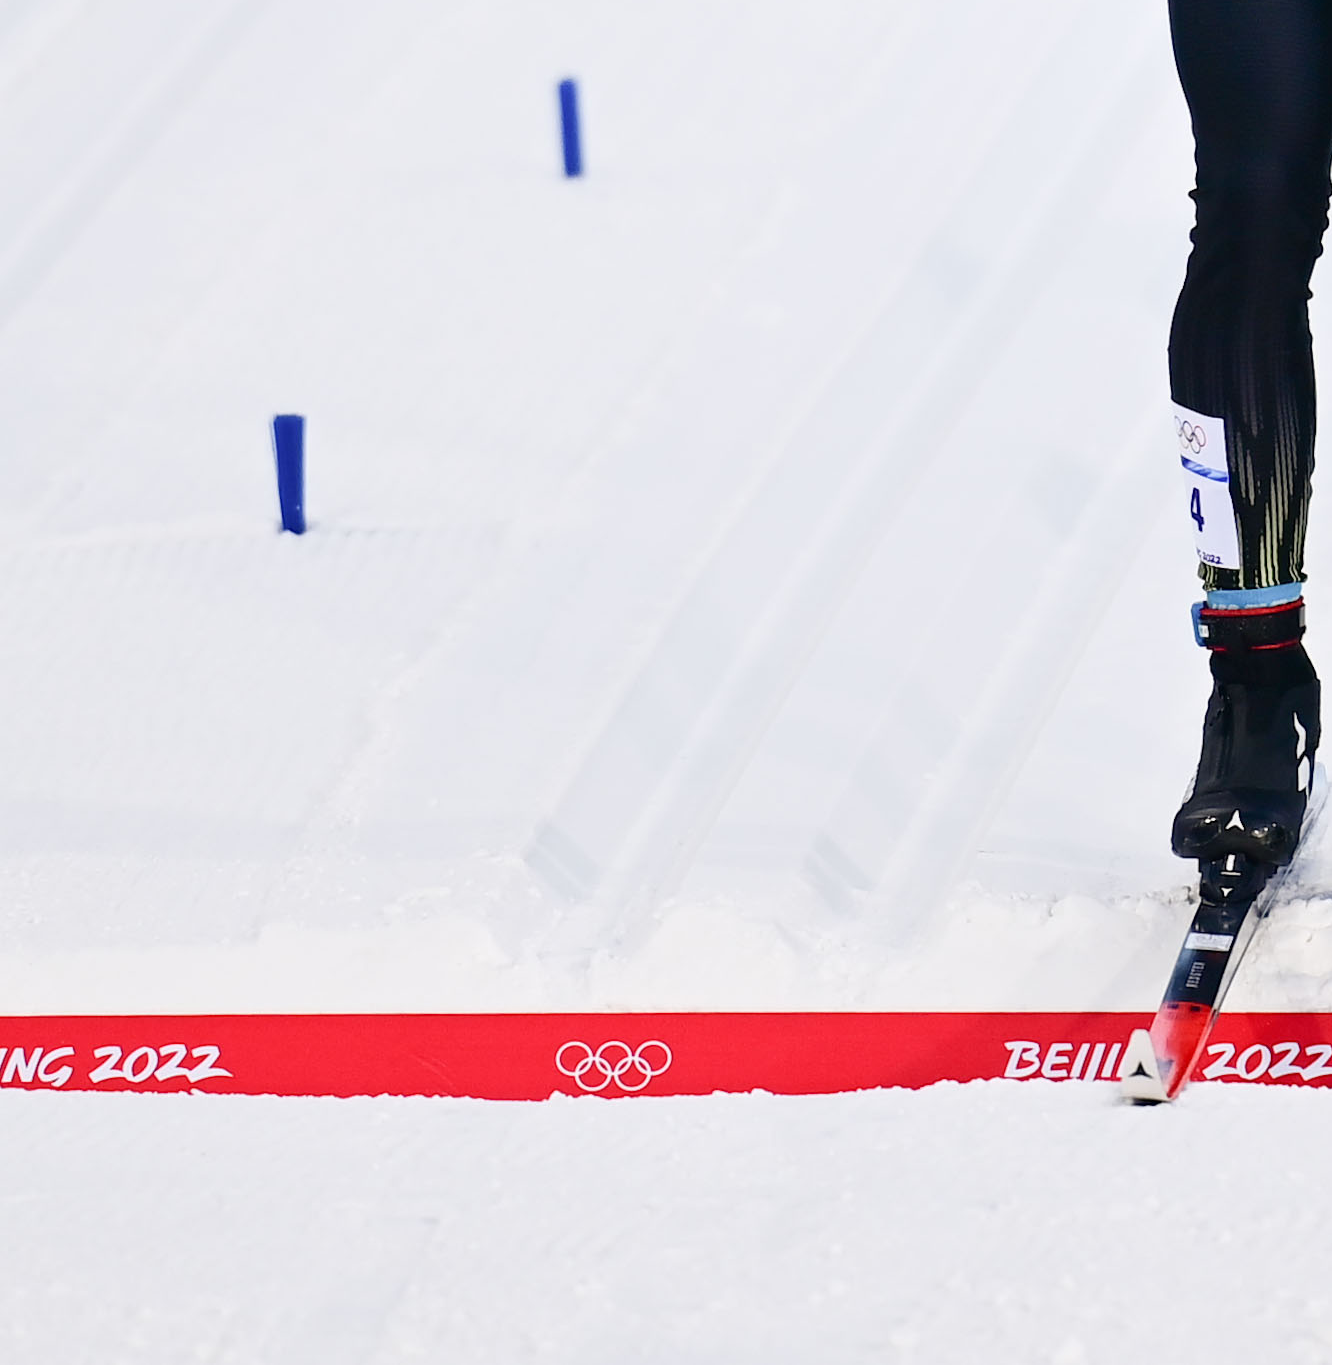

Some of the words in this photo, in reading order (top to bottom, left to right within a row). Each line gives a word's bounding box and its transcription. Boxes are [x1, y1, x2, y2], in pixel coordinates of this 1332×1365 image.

[1190, 487, 1205, 533] 4
[0, 1046, 75, 1088] NG
[88, 1043, 233, 1084] 2022
[1004, 1041, 1122, 1082] BEIJI
